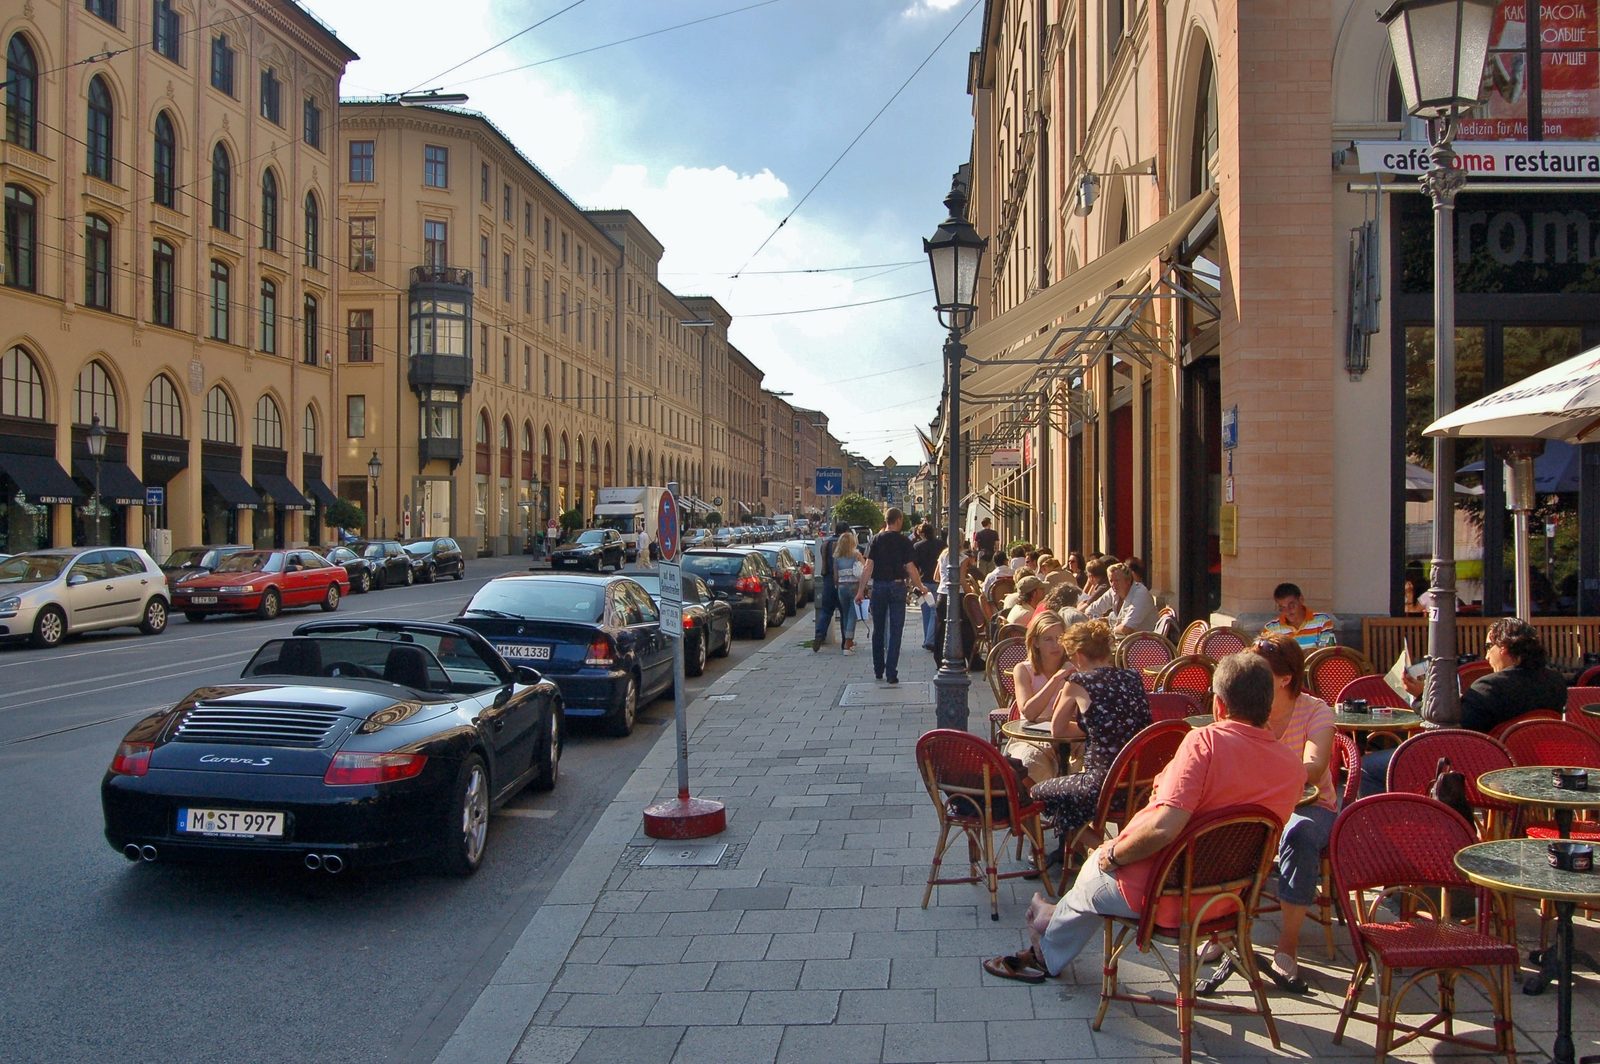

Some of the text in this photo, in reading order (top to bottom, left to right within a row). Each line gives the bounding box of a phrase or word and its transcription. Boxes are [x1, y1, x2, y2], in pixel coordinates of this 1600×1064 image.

[1539, 5, 1586, 20] РАСОТА
[1540, 27, 1586, 42] ОЛЬШЕ
[1457, 121, 1562, 135] Medizin für Mehen
[1383, 148, 1430, 170] café
[1450, 154, 1495, 171] oma
[1458, 210, 1600, 264] rom
[509, 646, 522, 657] KK
[524, 647, 549, 658] 1338
[199, 754, 273, 766] Carrera S
[192, 811, 277, 832] M ST 997
